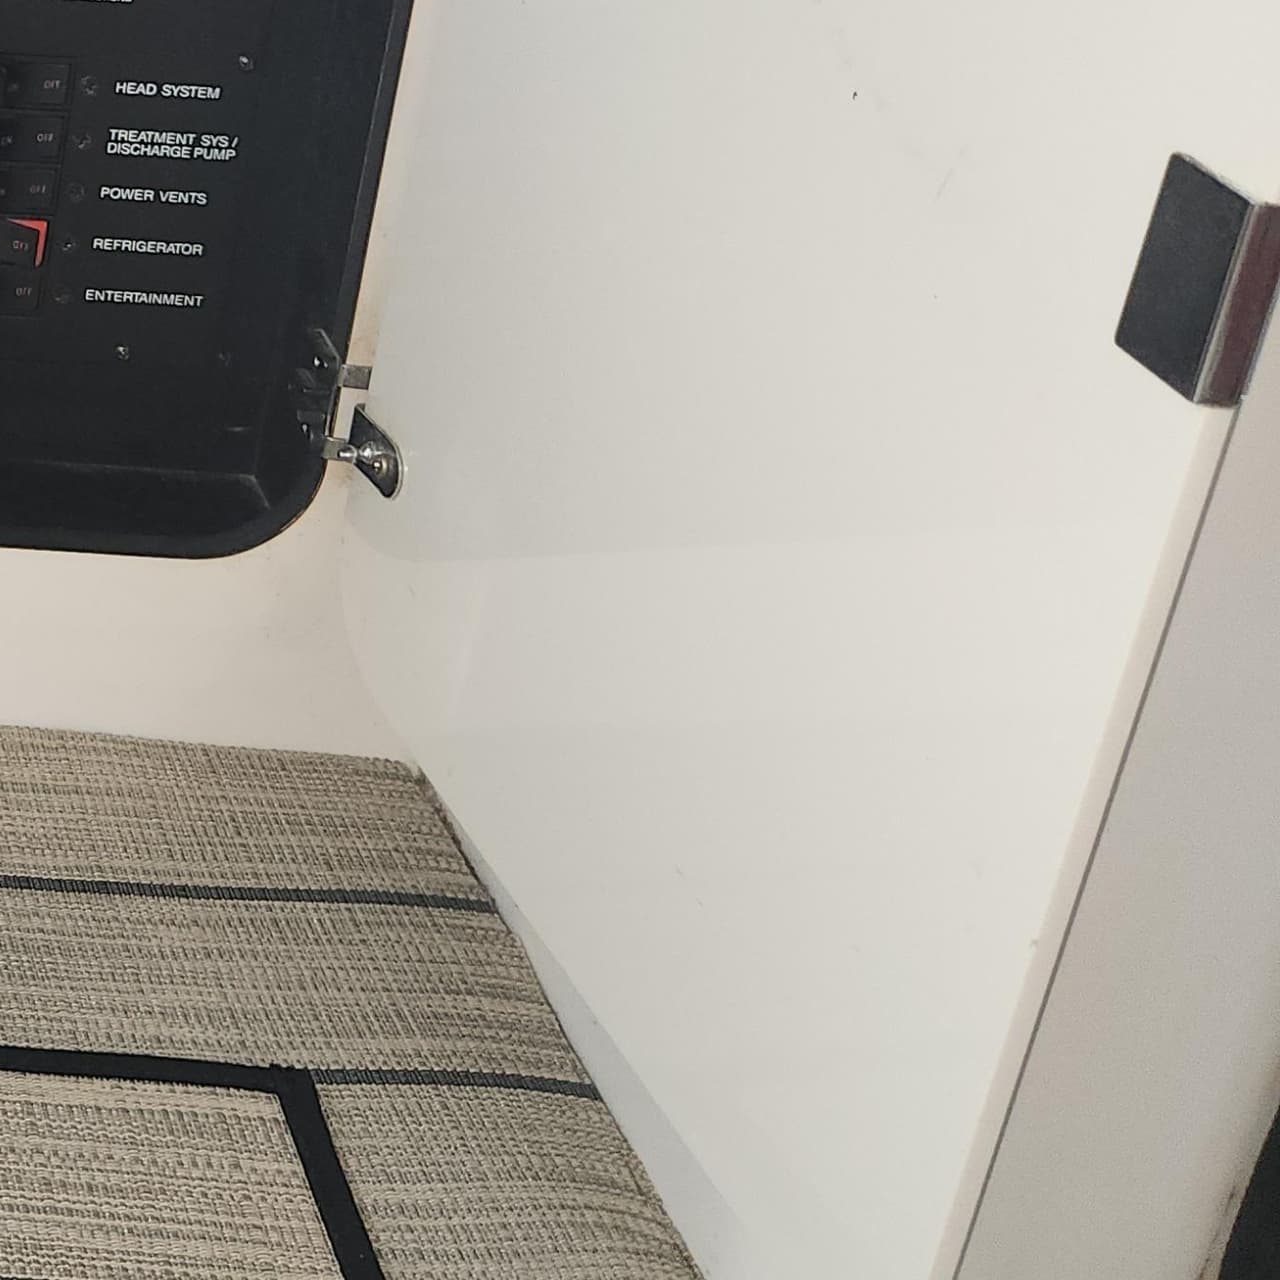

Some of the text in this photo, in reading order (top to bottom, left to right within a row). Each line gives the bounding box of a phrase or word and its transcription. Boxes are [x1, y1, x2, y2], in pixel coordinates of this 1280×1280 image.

[115, 82, 221, 99] HEAD SYSTEM
[108, 128, 196, 146] TREATMENT
[106, 141, 236, 161] DISCHARGE PUMP
[100, 186, 207, 205] POWER VENTS
[92, 238, 203, 256] REFRIGERATOR
[85, 289, 204, 307] ENTERTAINMENT
